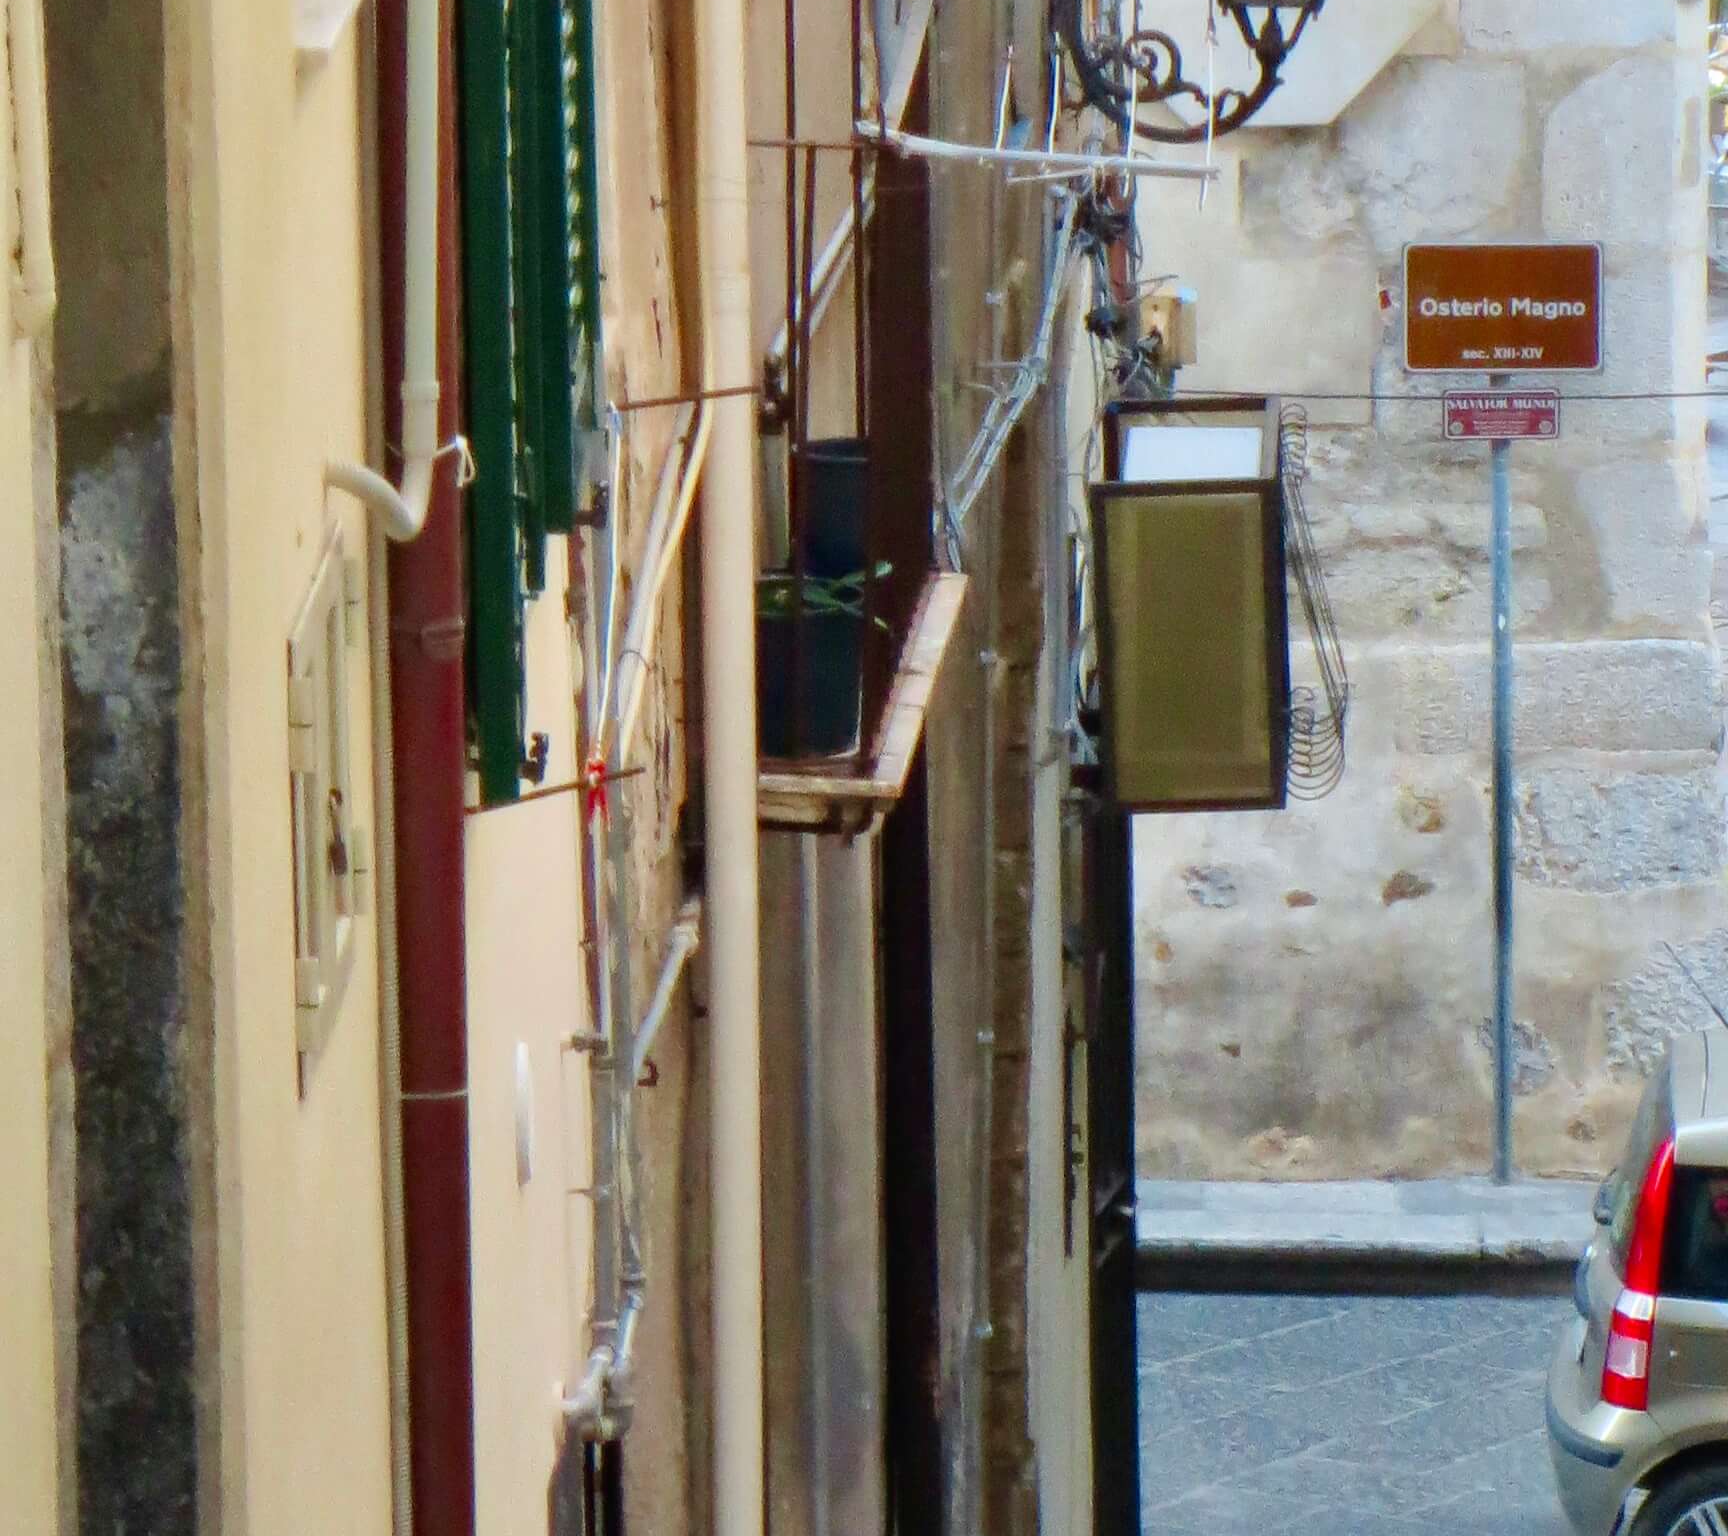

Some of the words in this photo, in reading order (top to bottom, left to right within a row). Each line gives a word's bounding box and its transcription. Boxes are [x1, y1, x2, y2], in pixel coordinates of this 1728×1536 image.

[1420, 297, 1502, 317] Osterio
[1511, 297, 1586, 319] Magno
[1461, 348, 1490, 360] sec.
